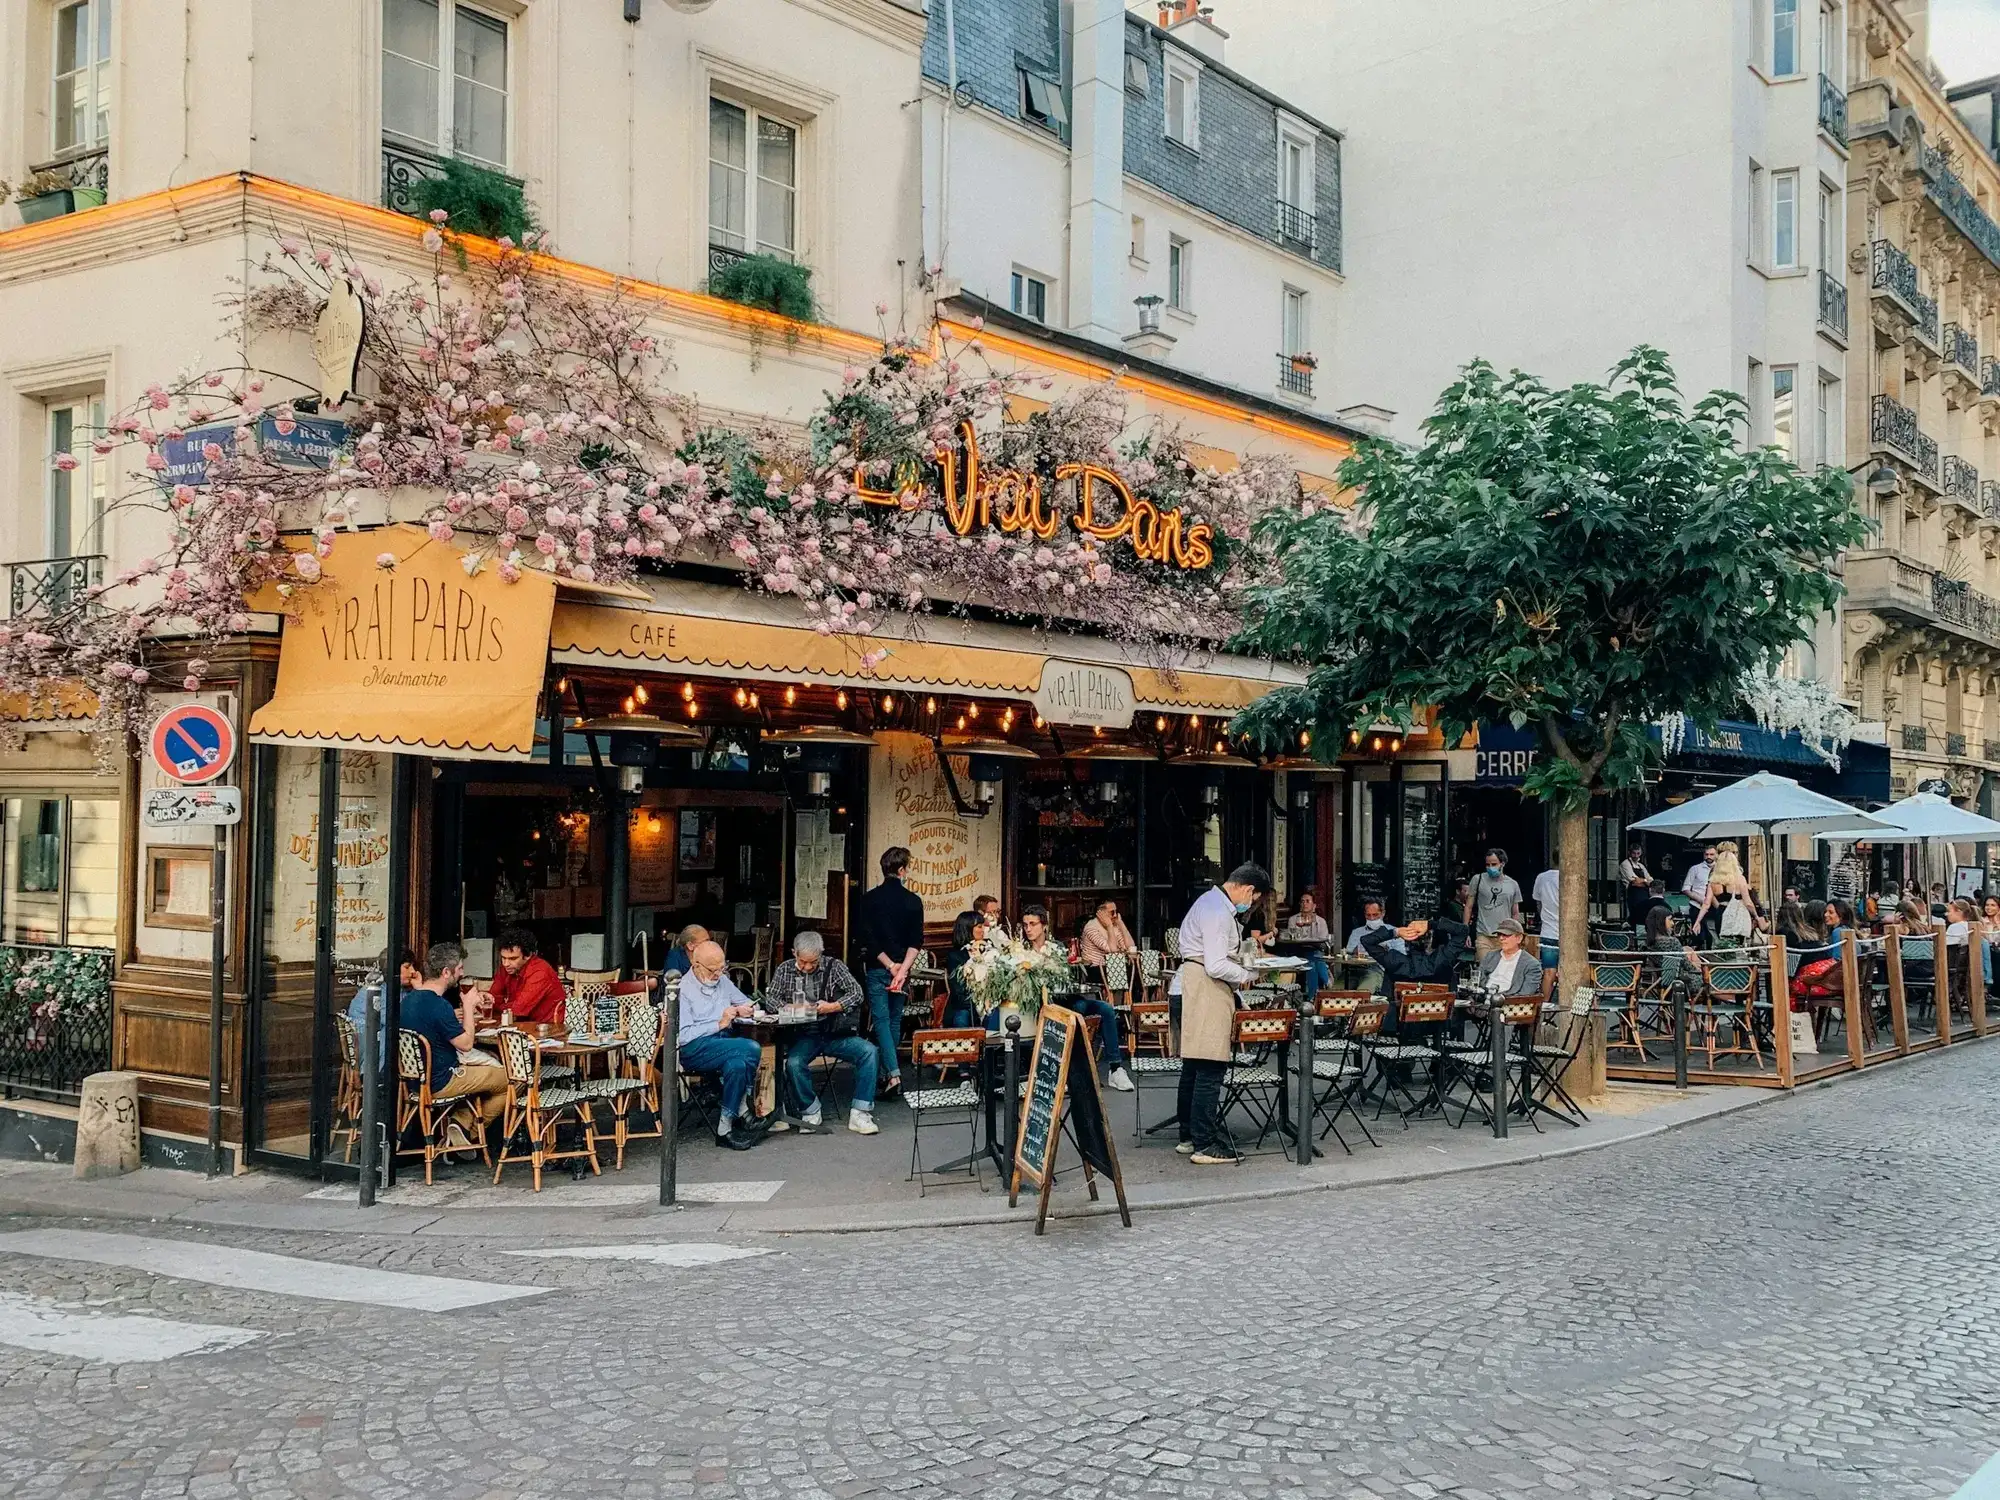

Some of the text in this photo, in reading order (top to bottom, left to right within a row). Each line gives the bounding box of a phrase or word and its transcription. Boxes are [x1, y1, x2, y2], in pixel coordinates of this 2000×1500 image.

[299, 428, 331, 441] RUE
[935, 417, 1058, 538] Vrai
[321, 577, 504, 662] VRAI PARIS
[630, 623, 677, 648] CAFÉ
[362, 665, 448, 688] Montmartre
[1047, 670, 1125, 711] VRAI PARIS
[1695, 727, 1706, 747] LE
[895, 786, 972, 816] Restaura
[908, 825, 969, 846] PRODUITS FRAIS
[934, 842, 943, 856] &
[908, 855, 968, 876] FAIT MAISON
[906, 869, 980, 895] TOUTE HEURE
